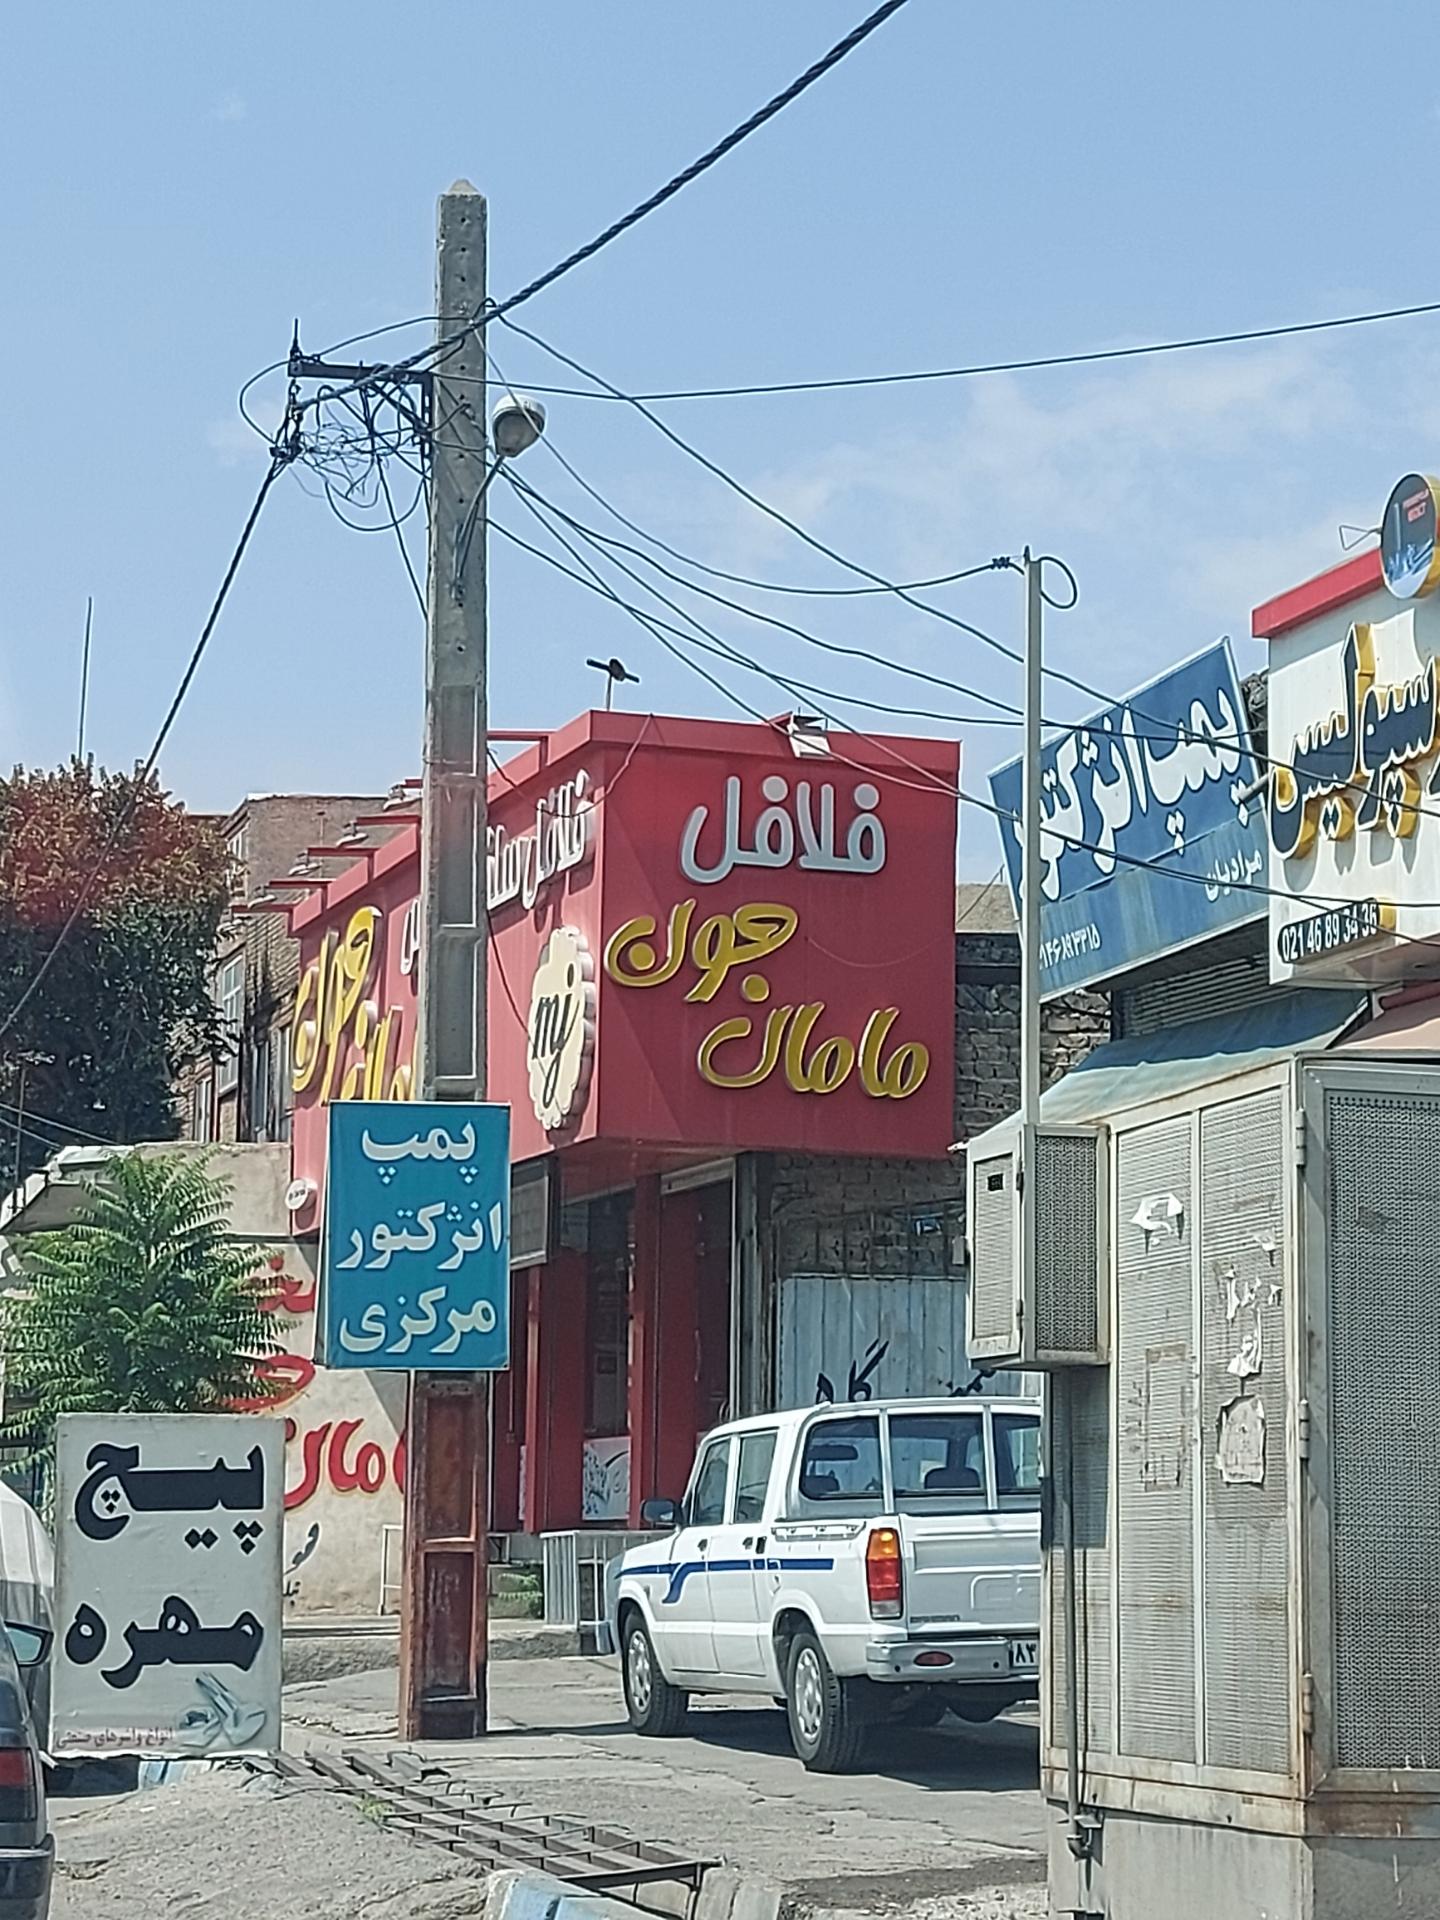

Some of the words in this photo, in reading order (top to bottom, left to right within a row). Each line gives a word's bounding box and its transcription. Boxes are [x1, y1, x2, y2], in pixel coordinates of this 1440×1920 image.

[680, 775, 886, 884] فلافل
[604, 898, 798, 1002] جون
[1282, 923, 1304, 962] 021
[1307, 917, 1321, 954] 46
[1325, 911, 1341, 949] 89
[1343, 904, 1359, 943] 34
[1361, 902, 1378, 938] 36
[697, 1001, 930, 1099] مامان
[362, 1119, 478, 1185] پمپ
[335, 1200, 503, 1270] انژکتور
[339, 1285, 498, 1354] مرکزی
[75, 1442, 265, 1555] پیچ
[65, 1595, 264, 1690] مهره
